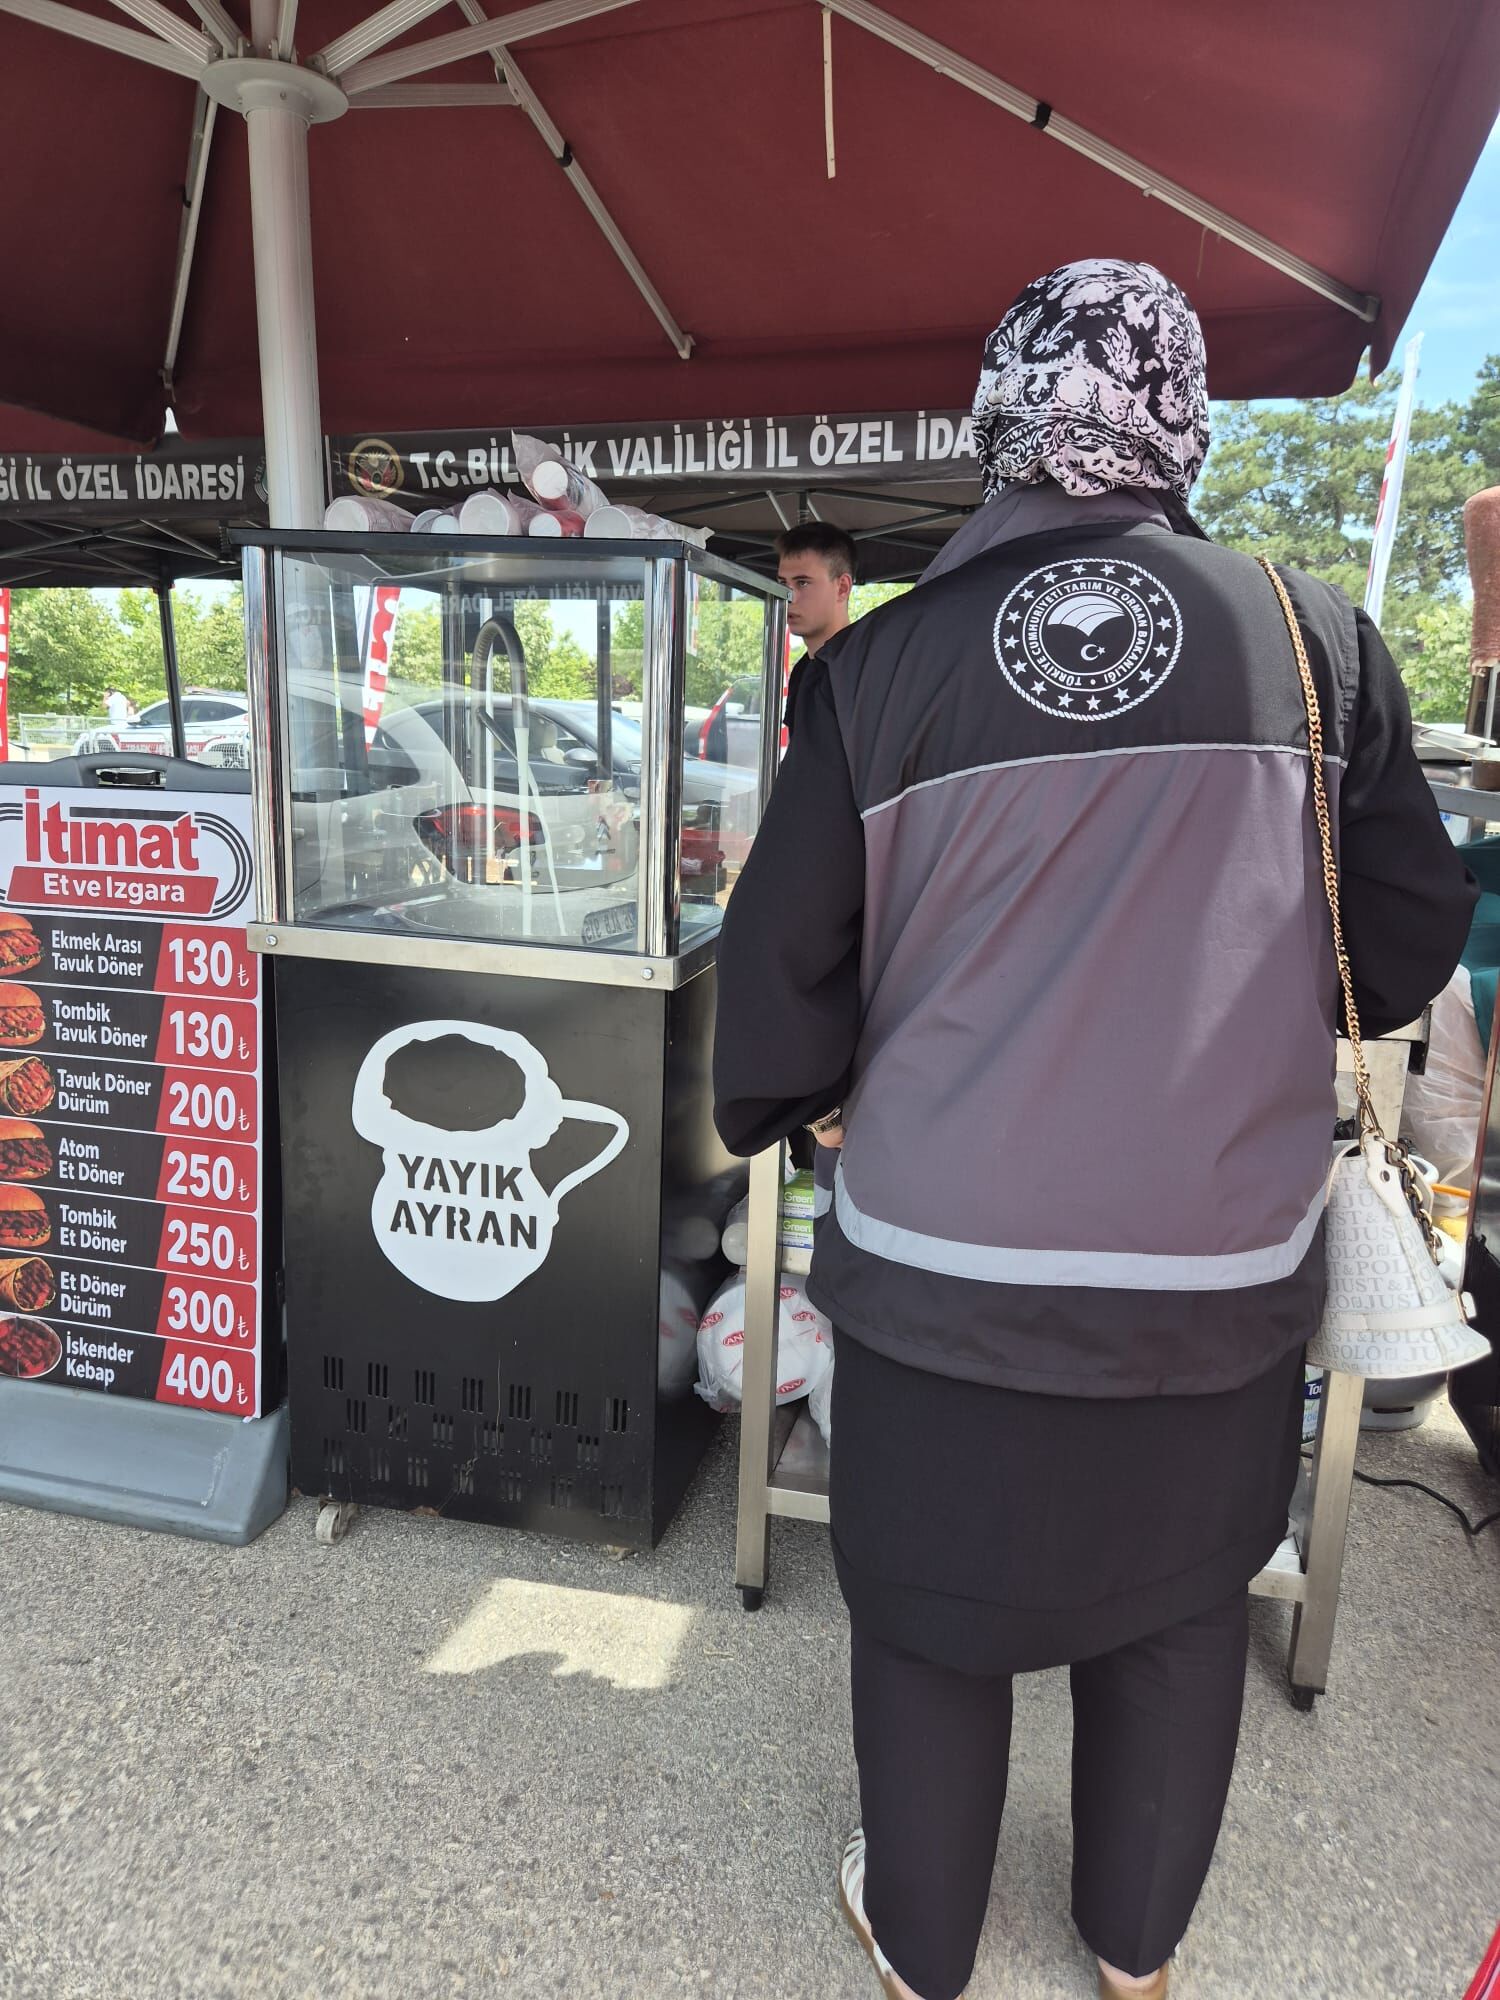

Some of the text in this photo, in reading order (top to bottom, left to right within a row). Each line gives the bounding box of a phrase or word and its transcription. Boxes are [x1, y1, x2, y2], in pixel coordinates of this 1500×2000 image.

[607, 419, 752, 477] VALİLİĞİ
[766, 417, 798, 468] İL
[810, 415, 903, 466] ÖZEL
[916, 410, 978, 461] İDA
[26, 457, 51, 500] İL
[57, 457, 128, 500] ÖZEL
[135, 455, 244, 500] İDARESİ
[1028, 582, 1148, 686] TÜRKİYE CUMHURİYETİ TARIM VE ORMAN BAKANLIĞI
[43, 873, 185, 905] Et ve Izgara
[51, 930, 142, 954] Ekmek Arası
[52, 953, 144, 976] Tavuk Döner
[53, 1000, 110, 1022] Tombik
[53, 1022, 148, 1048] Tavuk Döner
[57, 1068, 151, 1096] Tavuk Döner
[58, 1093, 109, 1115] Dürüm
[59, 1137, 100, 1159] Atom
[59, 1160, 125, 1186] Et Döner
[398, 1153, 524, 1201] YAYIK
[784, 1191, 813, 1205] Green
[60, 1204, 117, 1229] Tombik
[390, 1200, 537, 1249] AYRAN
[783, 1220, 812, 1233] Green
[60, 1227, 127, 1254] Et Döner
[60, 1271, 126, 1298] Et Döner
[60, 1294, 111, 1319] Dürüm
[66, 1332, 133, 1364] İskender
[66, 1358, 115, 1386] Kebap
